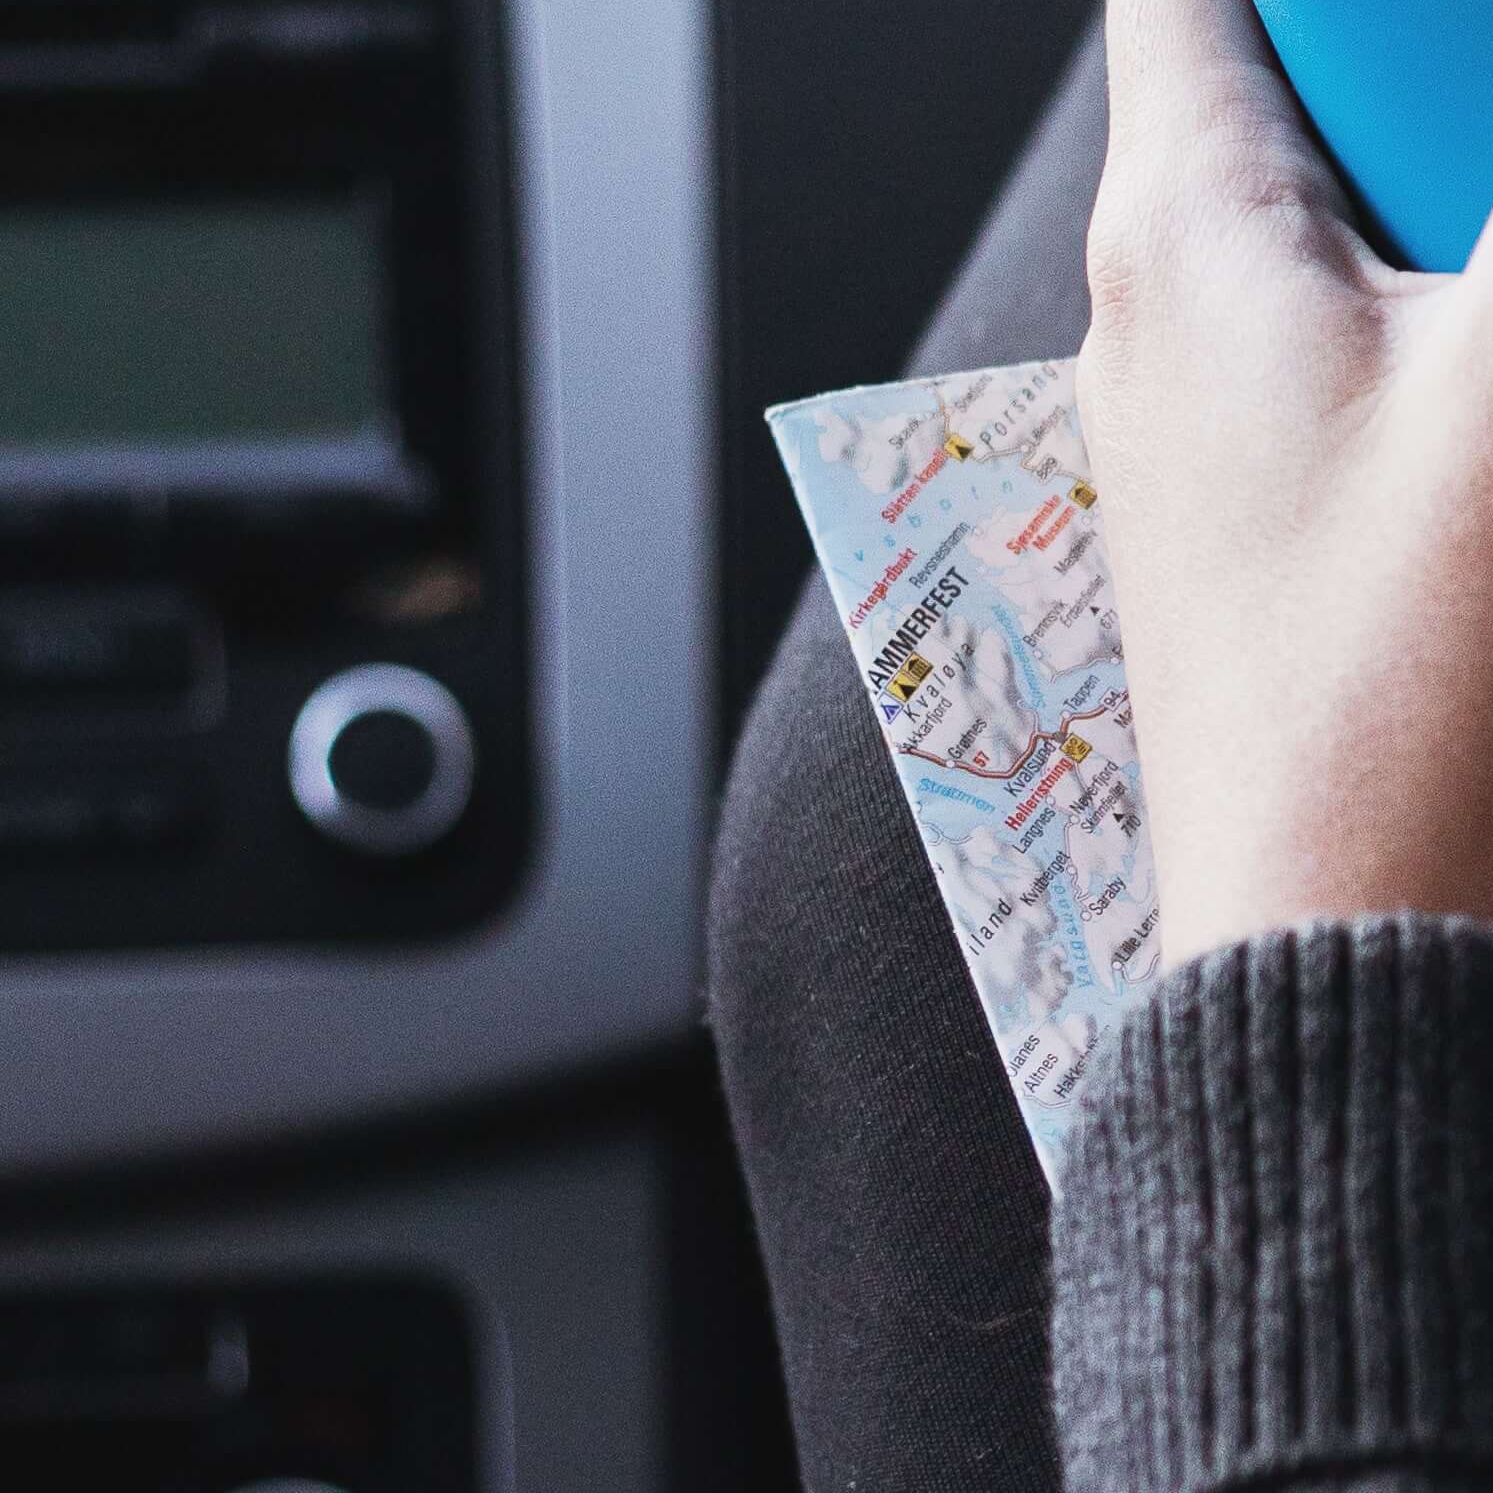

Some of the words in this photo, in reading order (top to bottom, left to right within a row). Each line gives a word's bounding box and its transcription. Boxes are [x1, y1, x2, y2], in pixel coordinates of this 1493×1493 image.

[872, 566, 970, 694] AMMERFEST
[1063, 674, 1100, 711] Tappen
[1103, 690, 1121, 708] 94
[1113, 705, 1134, 729] Ma
[1004, 757, 1073, 832] Helleristning
[1012, 806, 1057, 855] Langnes
[1088, 876, 1127, 916] Saraby
[1023, 1053, 1059, 1093] Altnes
